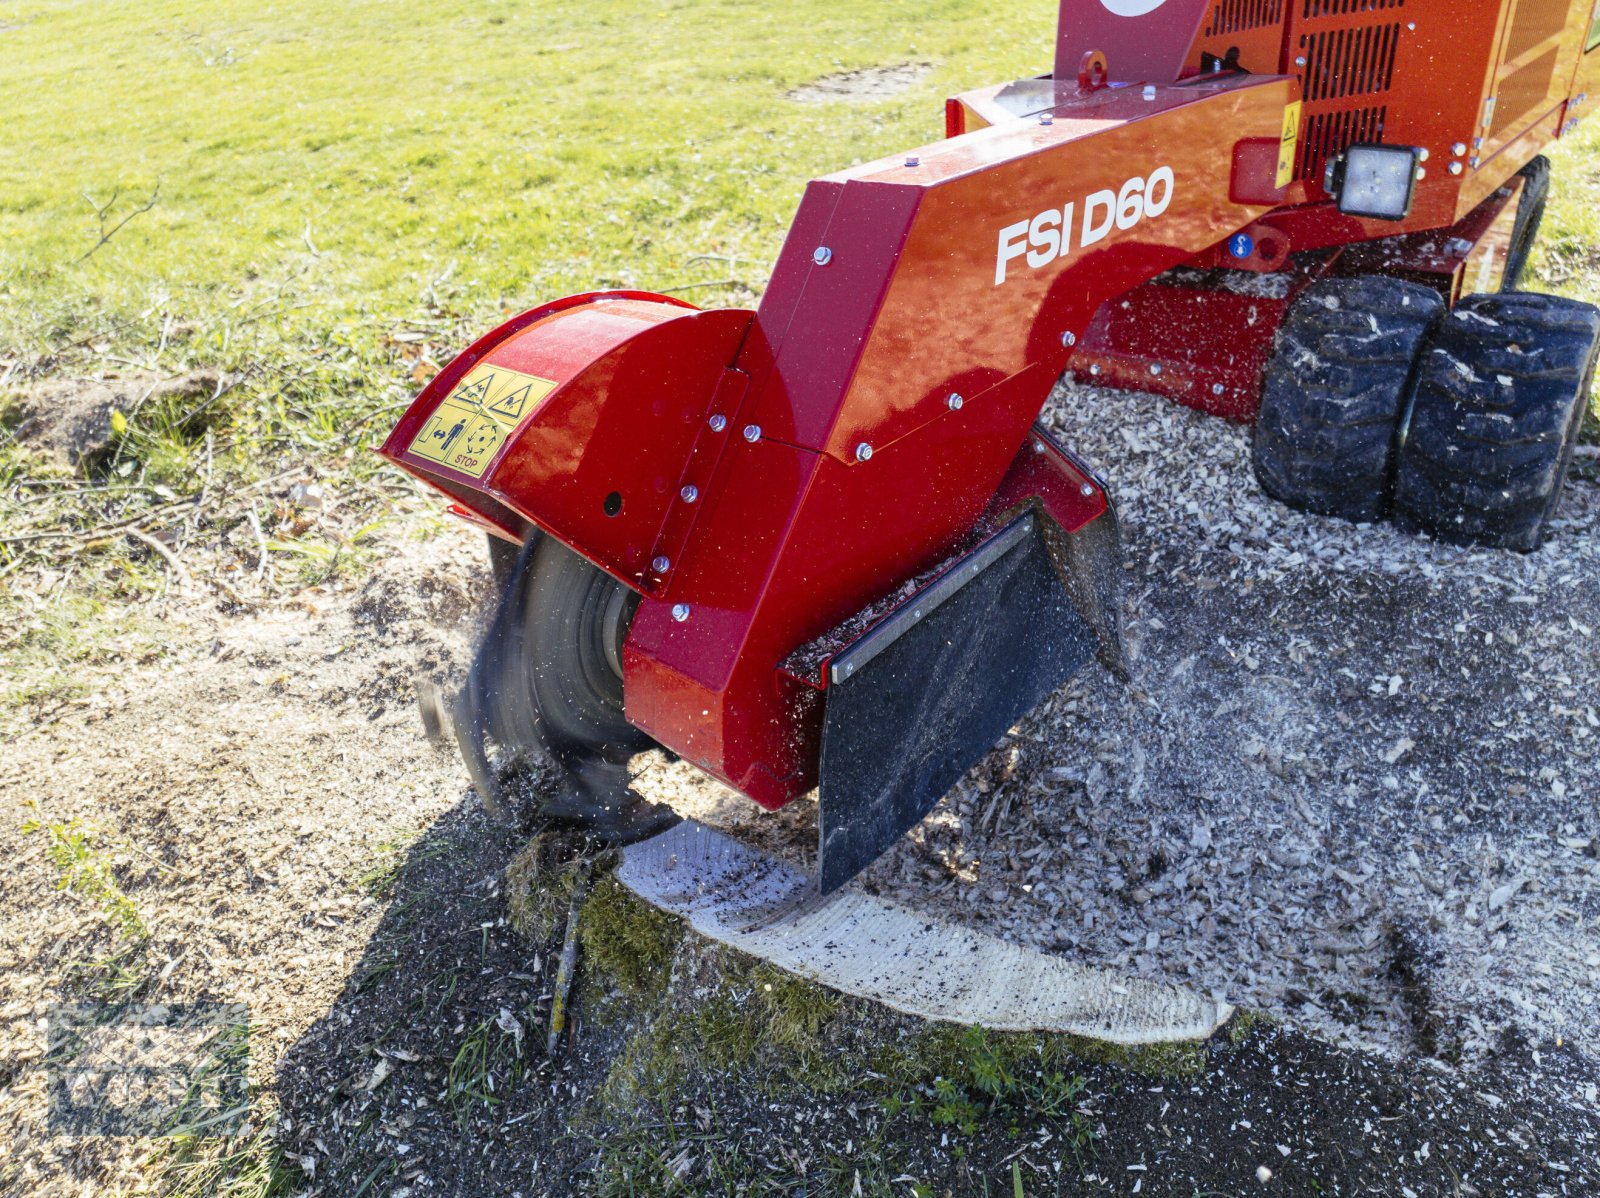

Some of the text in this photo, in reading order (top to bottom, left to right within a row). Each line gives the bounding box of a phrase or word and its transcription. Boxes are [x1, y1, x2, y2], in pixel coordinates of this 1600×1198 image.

[995, 165, 1174, 286] FSI D60
[454, 454, 478, 468] STOP
